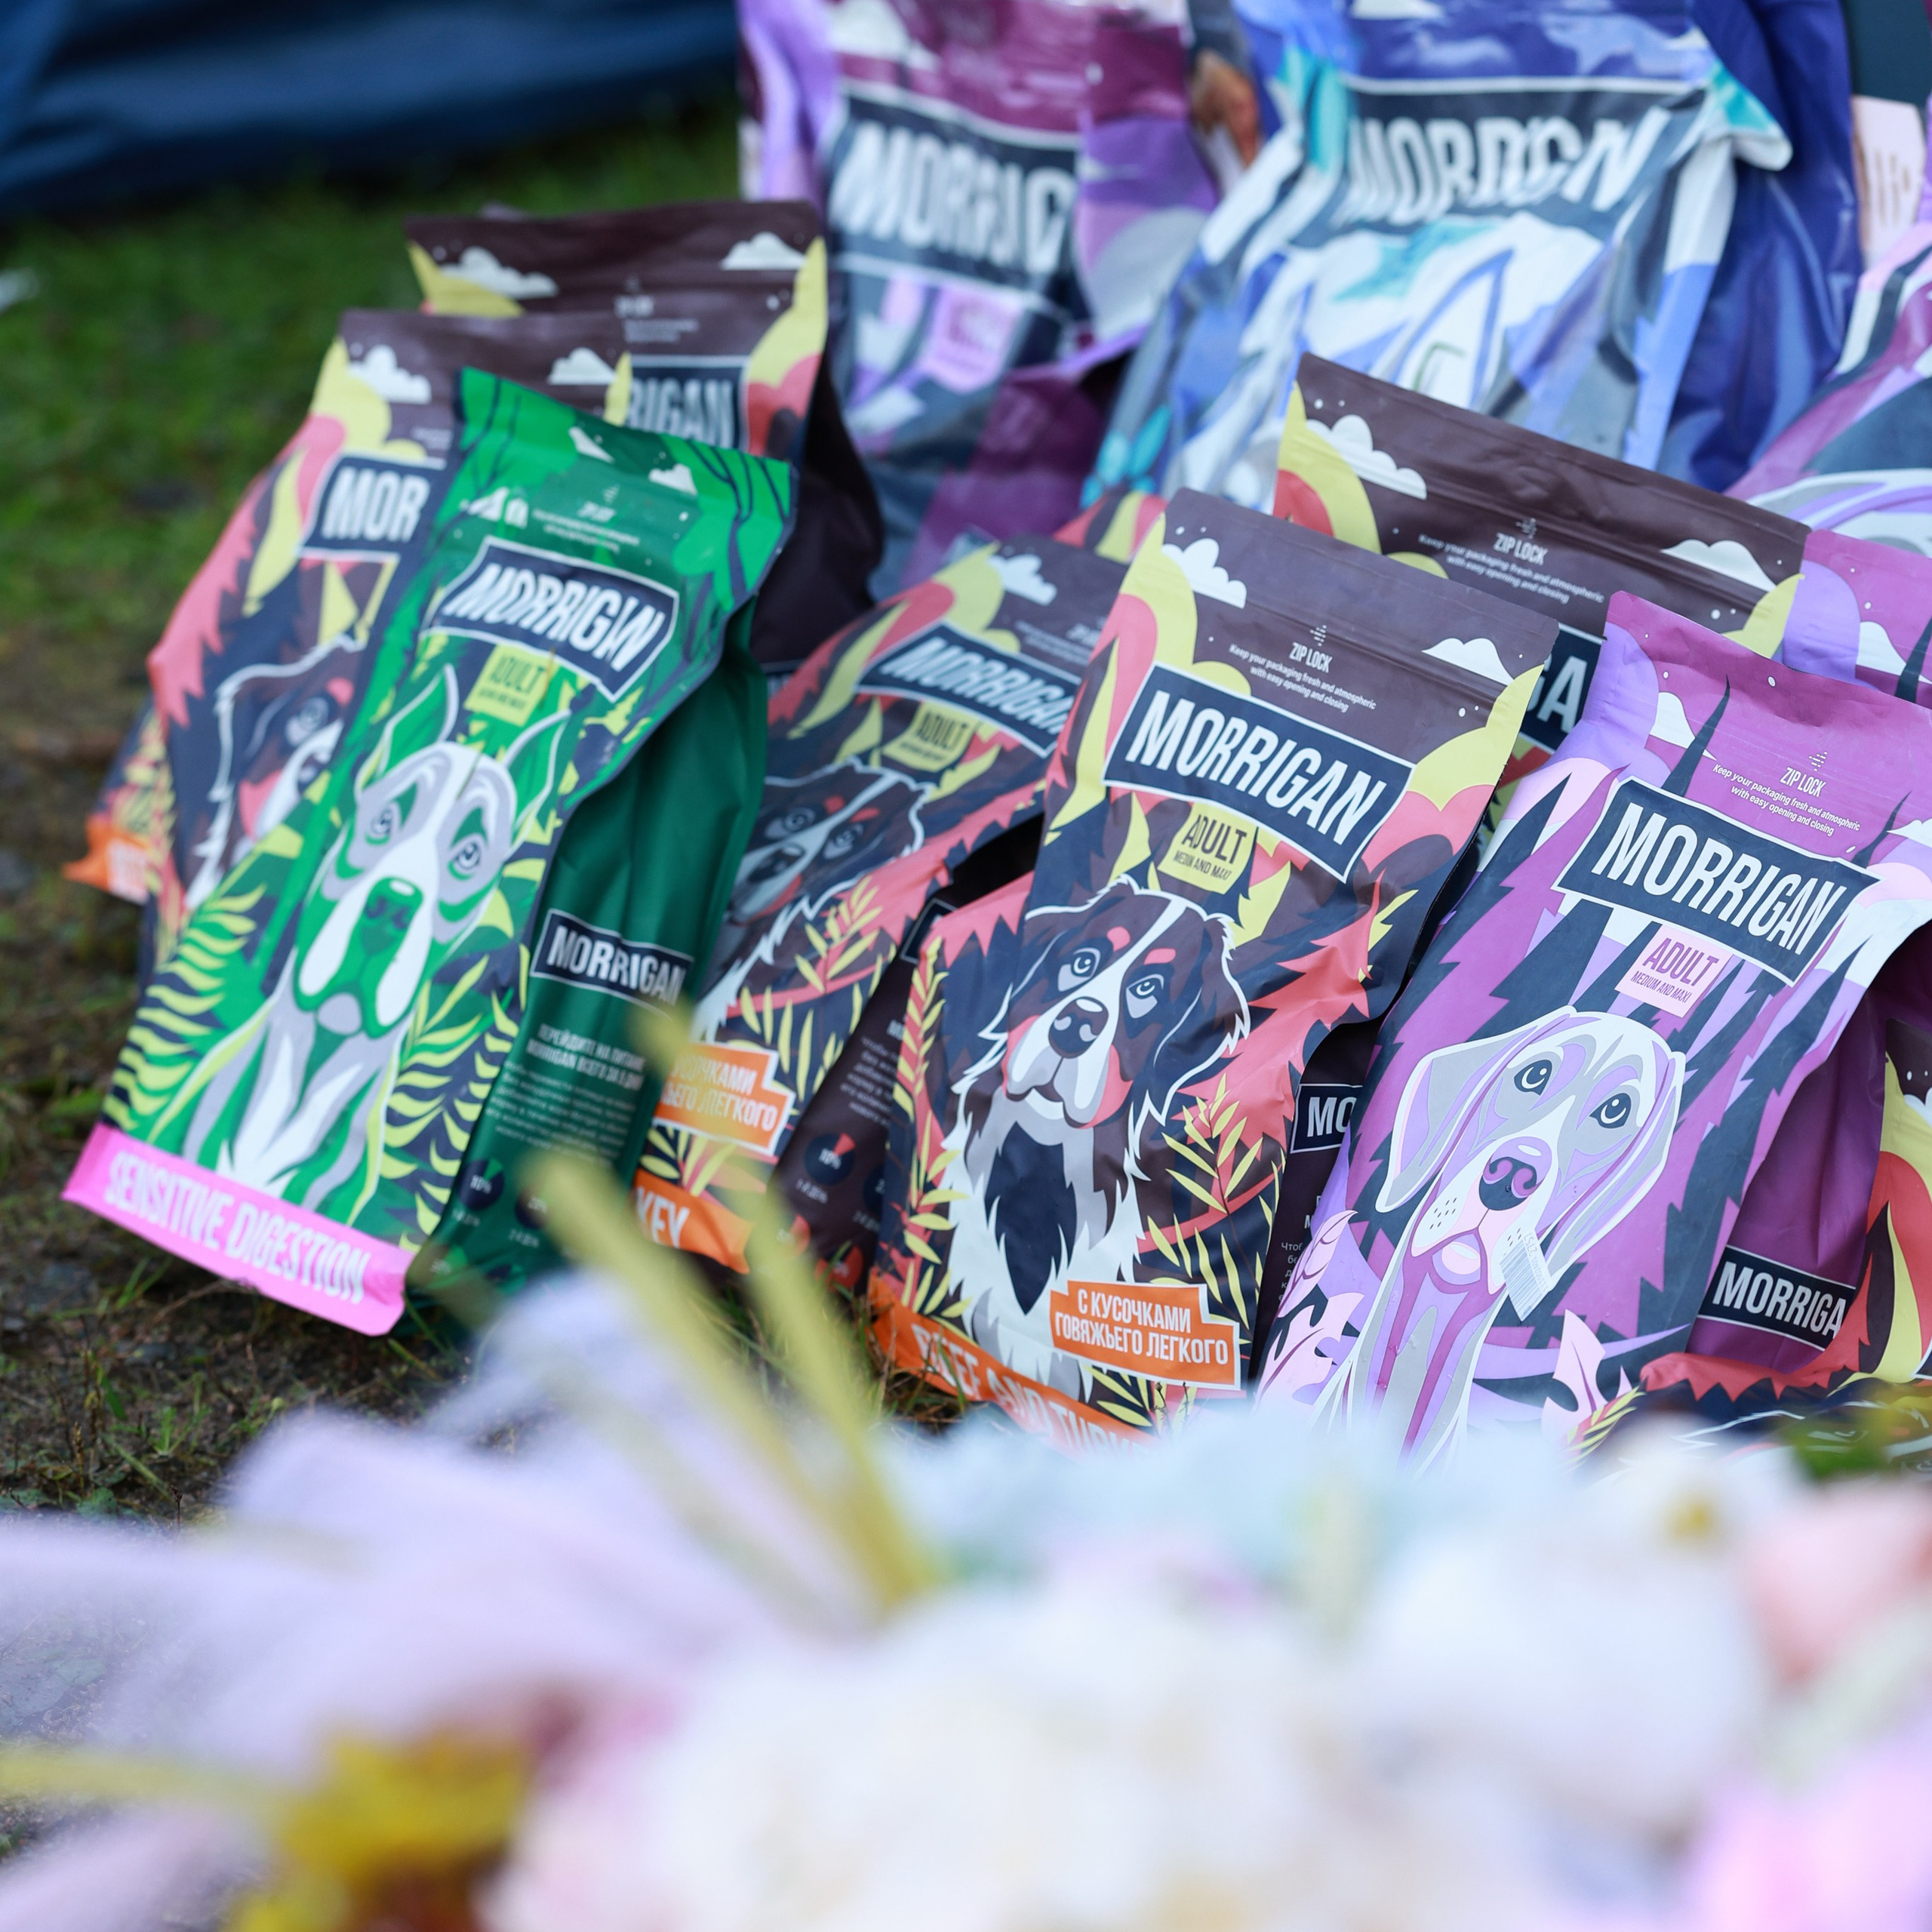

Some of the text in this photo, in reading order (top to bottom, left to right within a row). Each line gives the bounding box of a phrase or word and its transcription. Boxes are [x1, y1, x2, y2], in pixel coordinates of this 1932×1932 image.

[1444, 543, 1466, 556] your
[1465, 549, 1509, 571] packaging
[1509, 563, 1533, 577] fresh
[1534, 571, 1549, 583] and
[1549, 576, 1604, 603] atmospheric
[1446, 555, 1466, 568] with
[1520, 580, 1537, 592] and
[1493, 532, 1548, 565] ZIP LOCK
[1229, 644, 1377, 710] Keep your packaging fresh and atmospheric
[1289, 642, 1333, 673] ZIP LOCK
[1250, 666, 1349, 713] with easy opening and closing
[1124, 690, 1387, 845] MORRIGAN
[1780, 767, 1826, 798] ZIP LOCK
[1712, 764, 1860, 831] Keep your packaging fresh and atmospheric
[1731, 786, 1835, 837] with easy opening and closing
[1181, 814, 1247, 864] ADULT
[1193, 857, 1212, 874] AND
[1591, 801, 1847, 956] MORRIGAN
[1642, 937, 1720, 986] ADULT
[1630, 971, 1692, 1003] MEDIUM AND MAXI
[105, 1150, 371, 1304] SENSITIVE DIGESTION
[1078, 1288, 1191, 1334] С КУСОЧКАМИ
[1712, 1260, 1847, 1339] MORRIGA
[1055, 1312, 1229, 1364] ГОВЯЖЬЕГО ЛЕГКОГО
